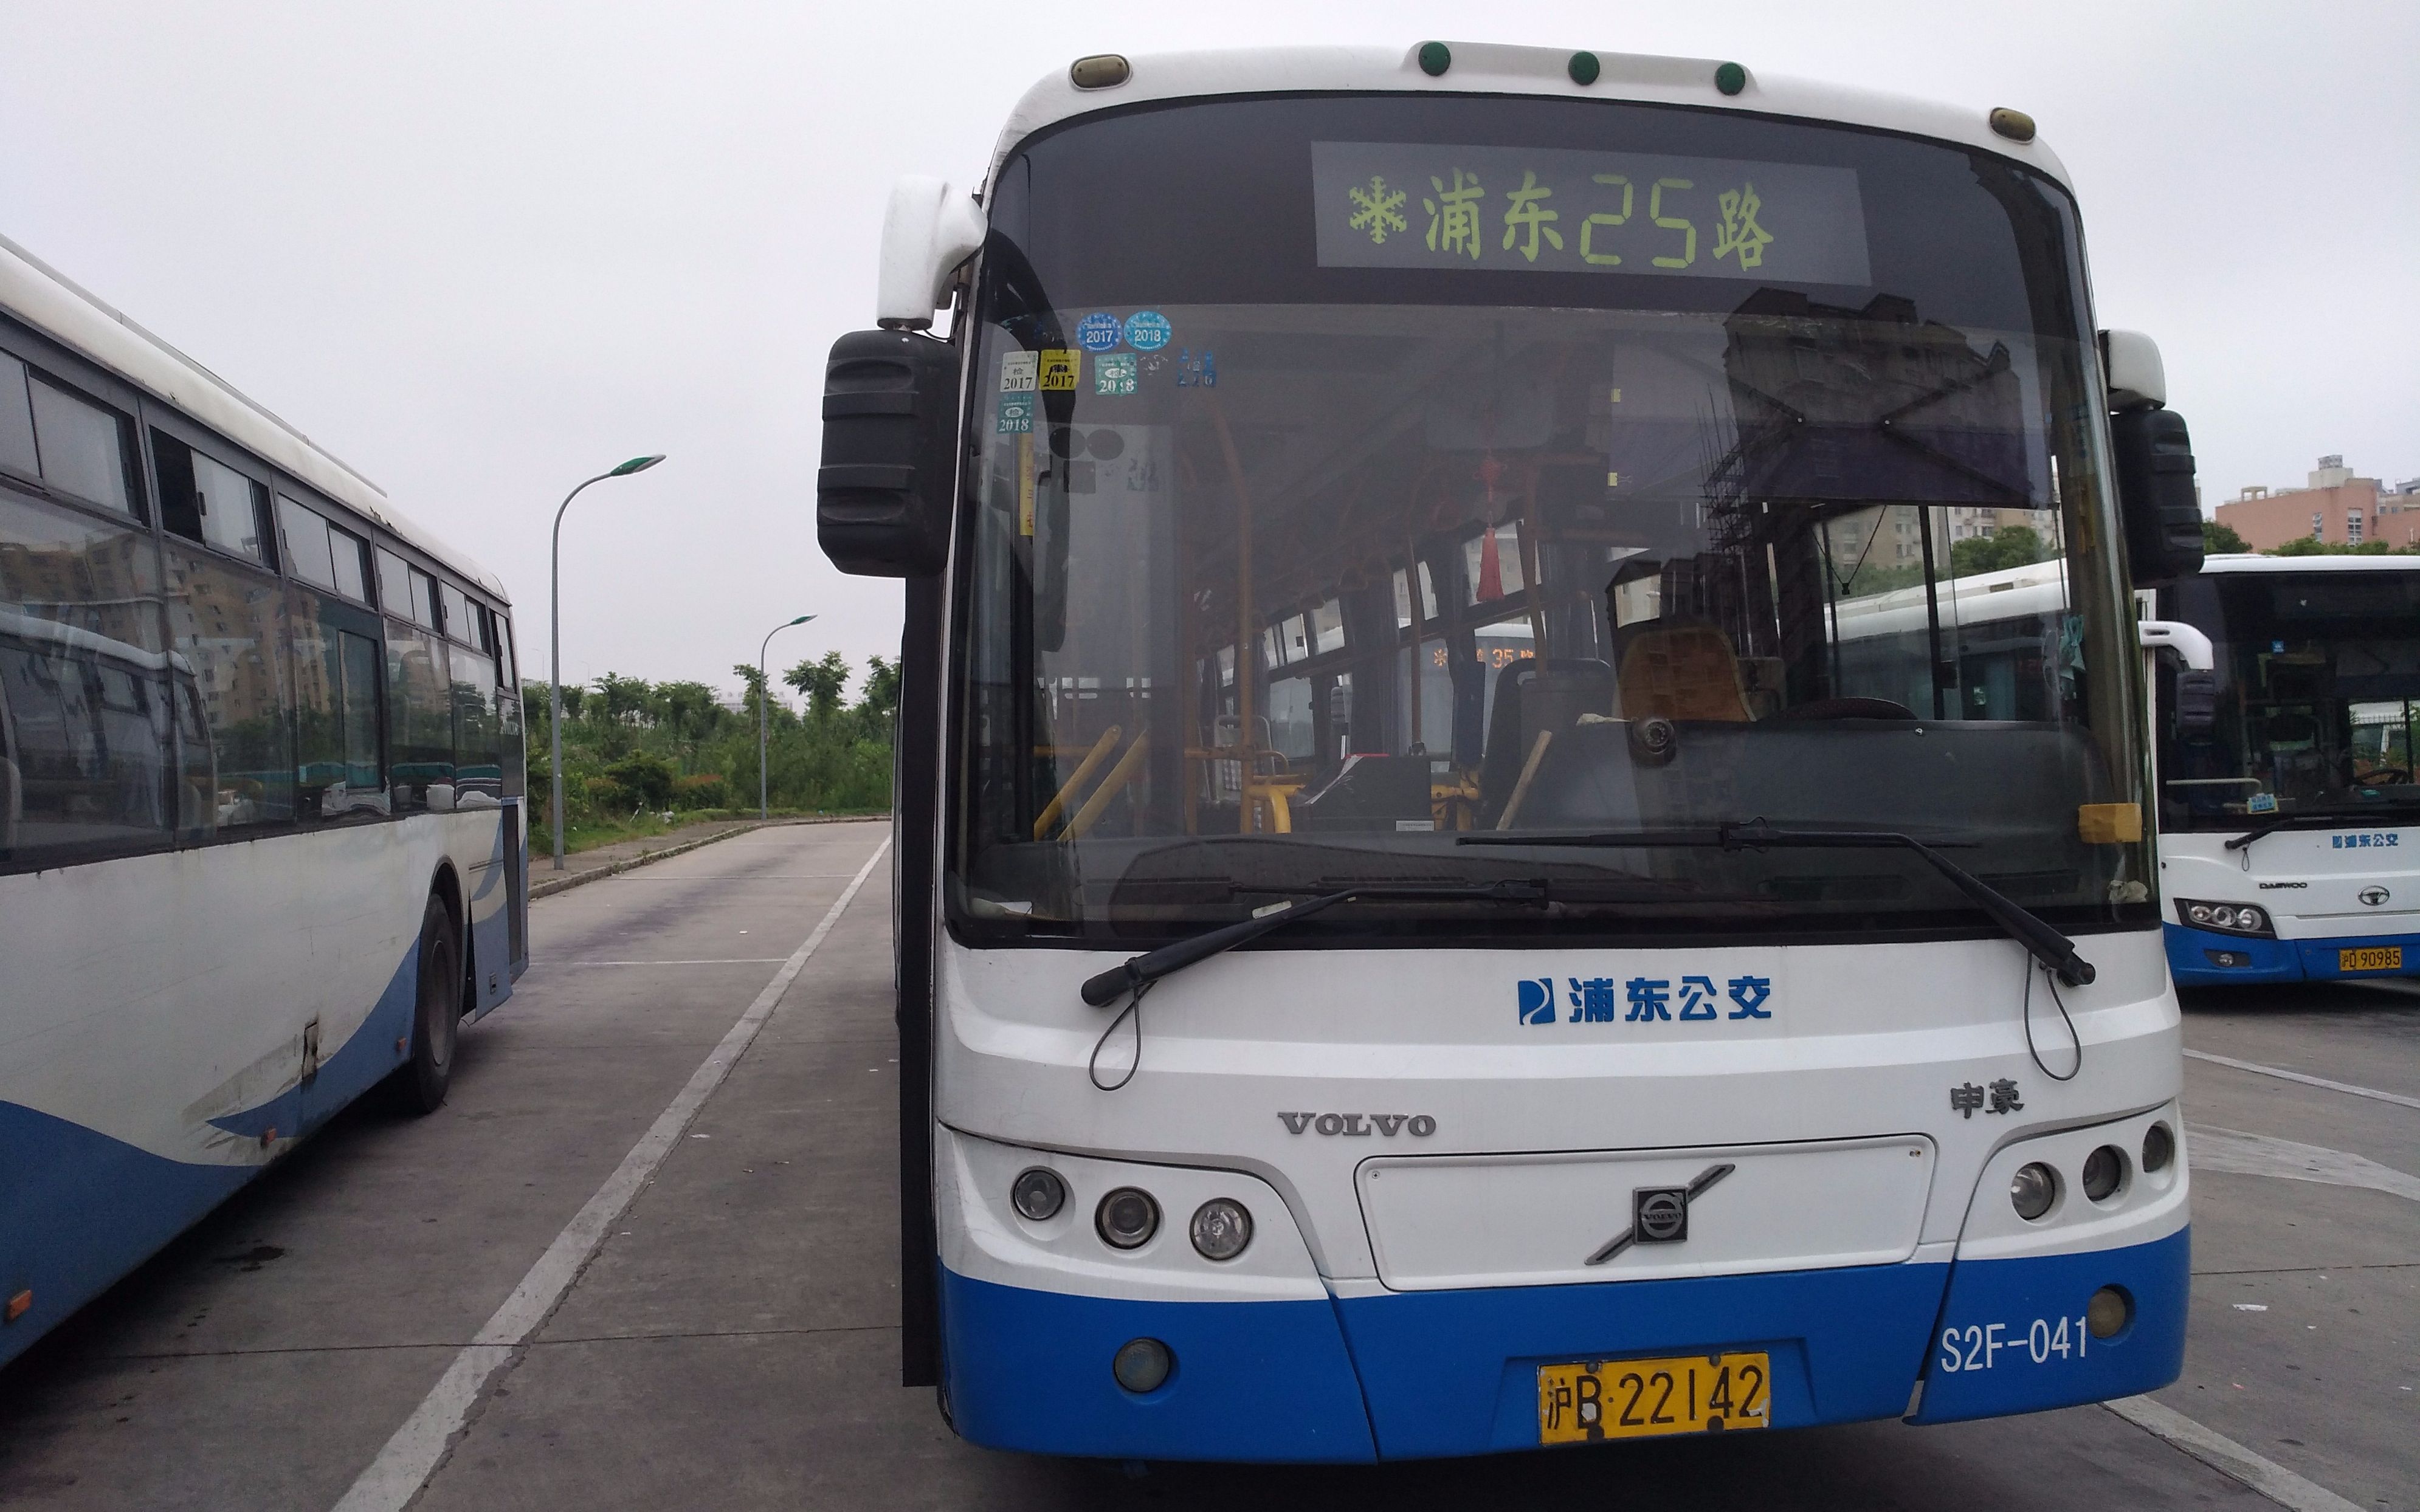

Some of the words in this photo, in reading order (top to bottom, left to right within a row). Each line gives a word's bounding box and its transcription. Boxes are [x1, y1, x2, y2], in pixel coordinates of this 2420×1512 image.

[1422, 167, 1773, 272] 浦东25路
[1086, 331, 1113, 343] 2017
[1134, 329, 1161, 342] 2018
[1004, 377, 1033, 390] 2017
[1043, 375, 1075, 388] 2017
[999, 418, 1029, 431] 2018
[1569, 975, 1771, 1022] 浦东公交
[1277, 1112, 1436, 1136] VOLVO
[1941, 1316, 2086, 1372] S2F-041
